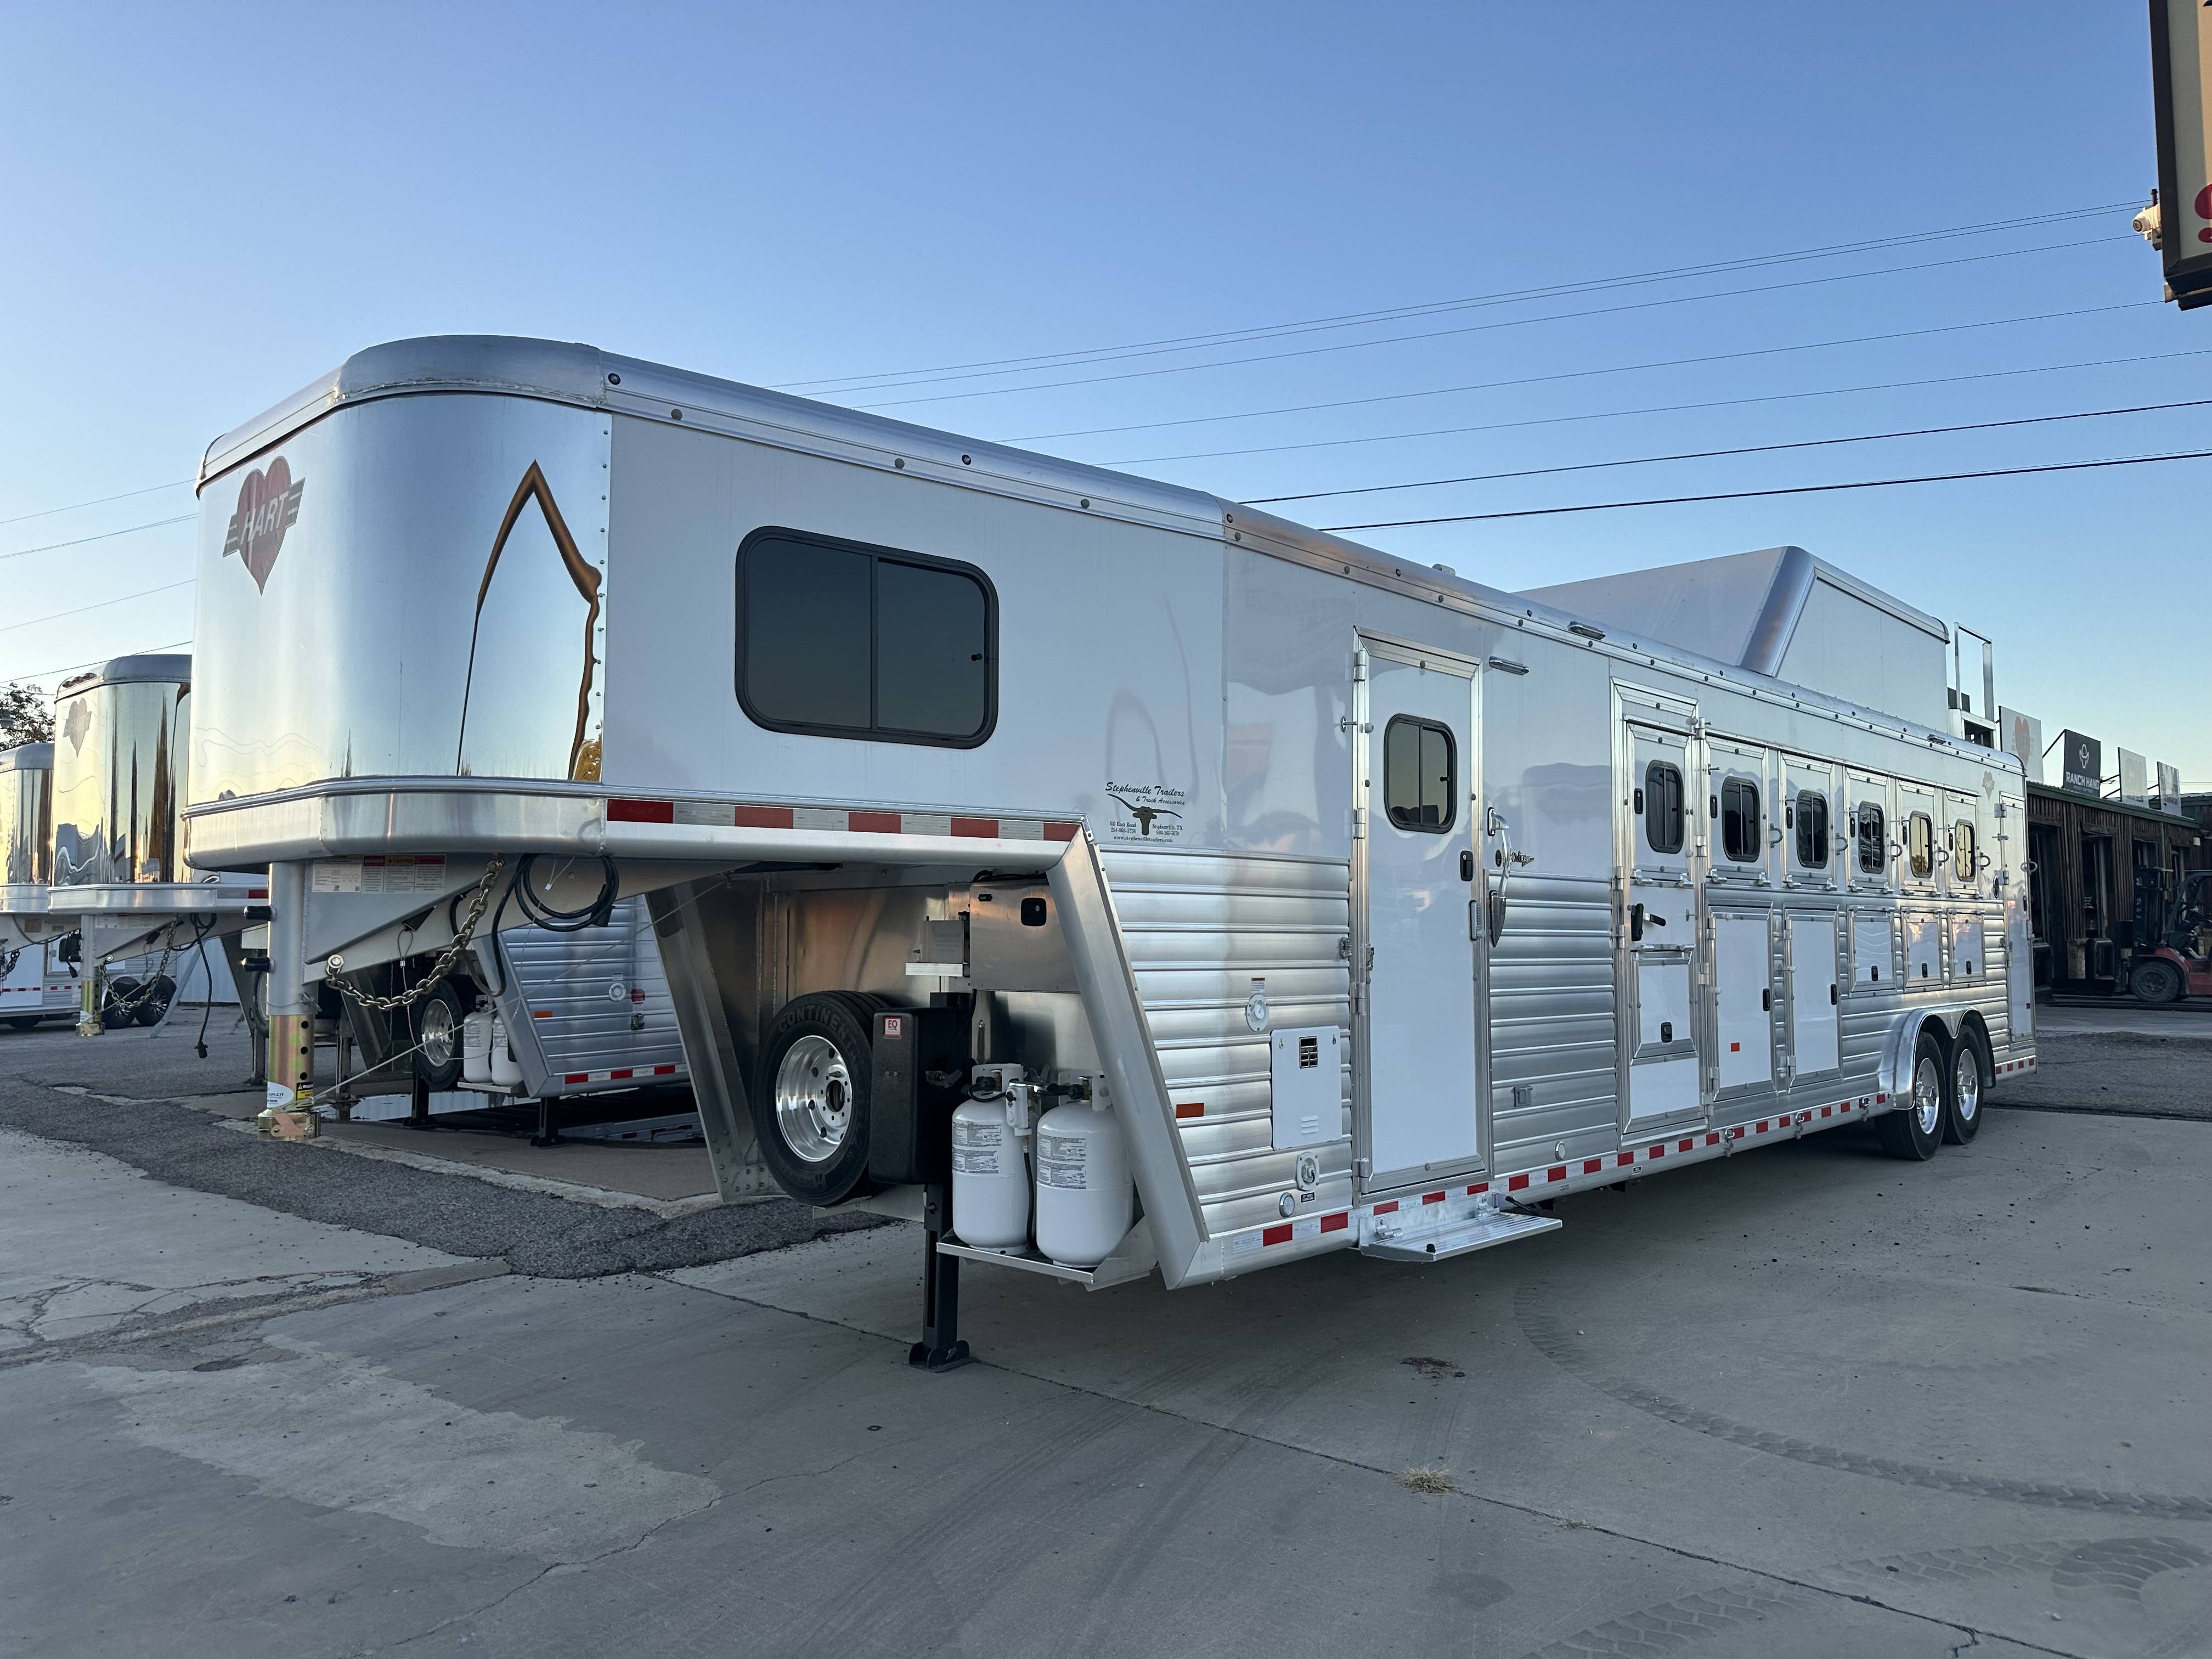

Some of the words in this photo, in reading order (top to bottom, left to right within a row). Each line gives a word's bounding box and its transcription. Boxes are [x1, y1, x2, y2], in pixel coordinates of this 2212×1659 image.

[240, 490, 289, 545] HART
[1105, 781, 1152, 794] Stephenville
[1154, 786, 1185, 797] Trailers
[2066, 771, 2085, 786] RANCH
[2086, 776, 2100, 790] HAND
[888, 1020, 898, 1030] EQ
